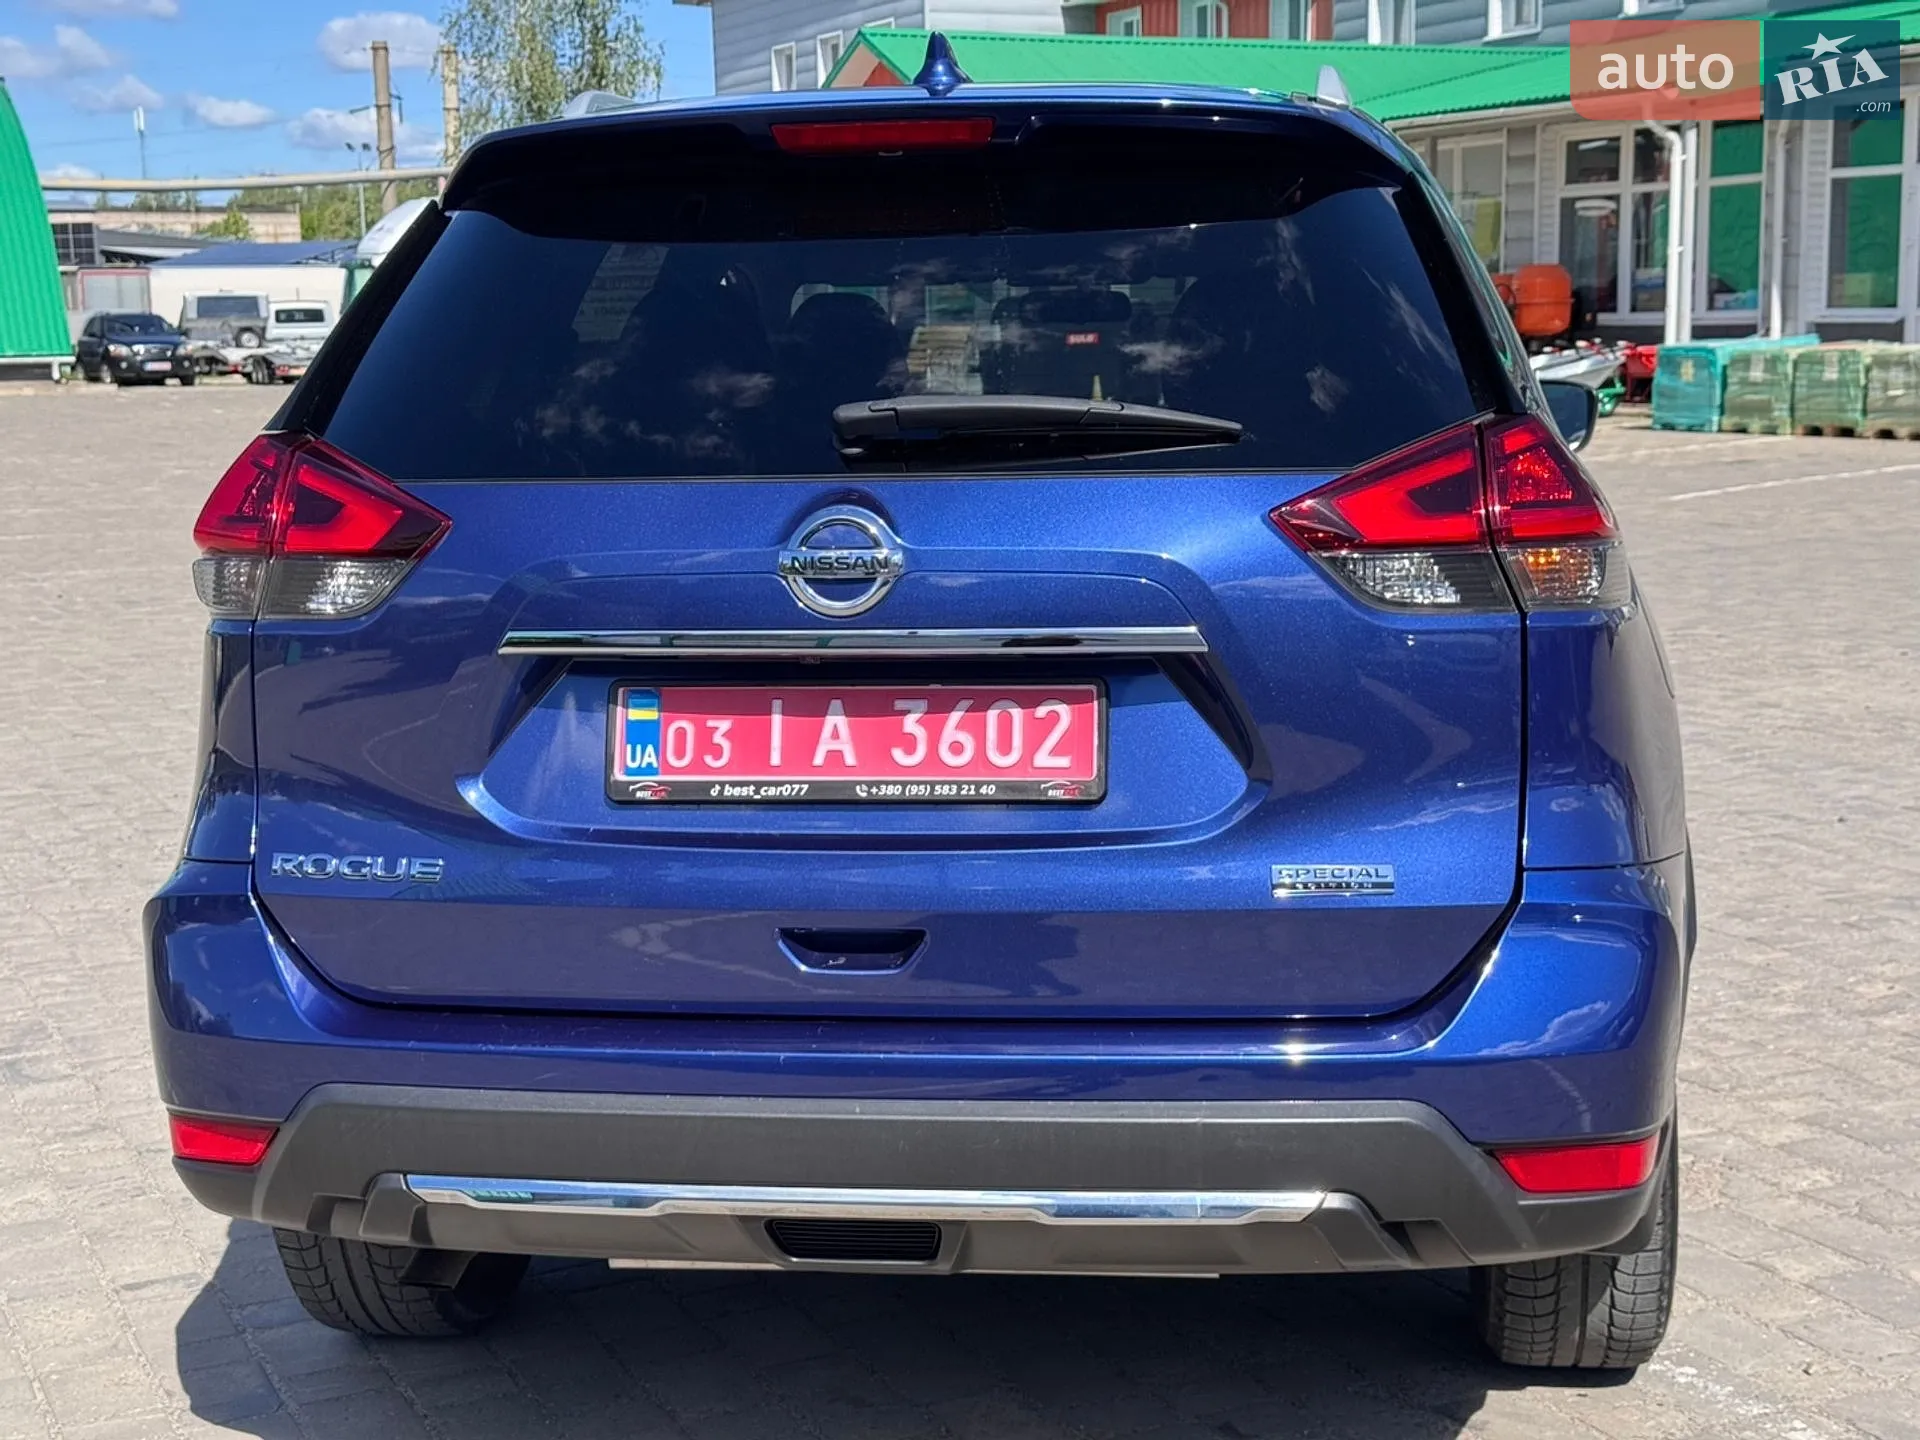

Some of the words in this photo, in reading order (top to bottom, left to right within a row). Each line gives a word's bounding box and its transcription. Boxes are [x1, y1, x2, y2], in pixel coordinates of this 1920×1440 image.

[790, 556, 888, 571] NISSAN
[666, 719, 733, 768] 03
[891, 699, 1073, 768] 3602
[626, 743, 658, 768] UA
[723, 784, 809, 799] best_car077
[870, 784, 902, 796] +380
[905, 783, 930, 797] (95)
[934, 784, 957, 796] 583
[960, 784, 976, 796] 21
[979, 784, 996, 796] 40
[271, 852, 444, 881] ROGUE
[1278, 867, 1389, 879] SPECIAL
